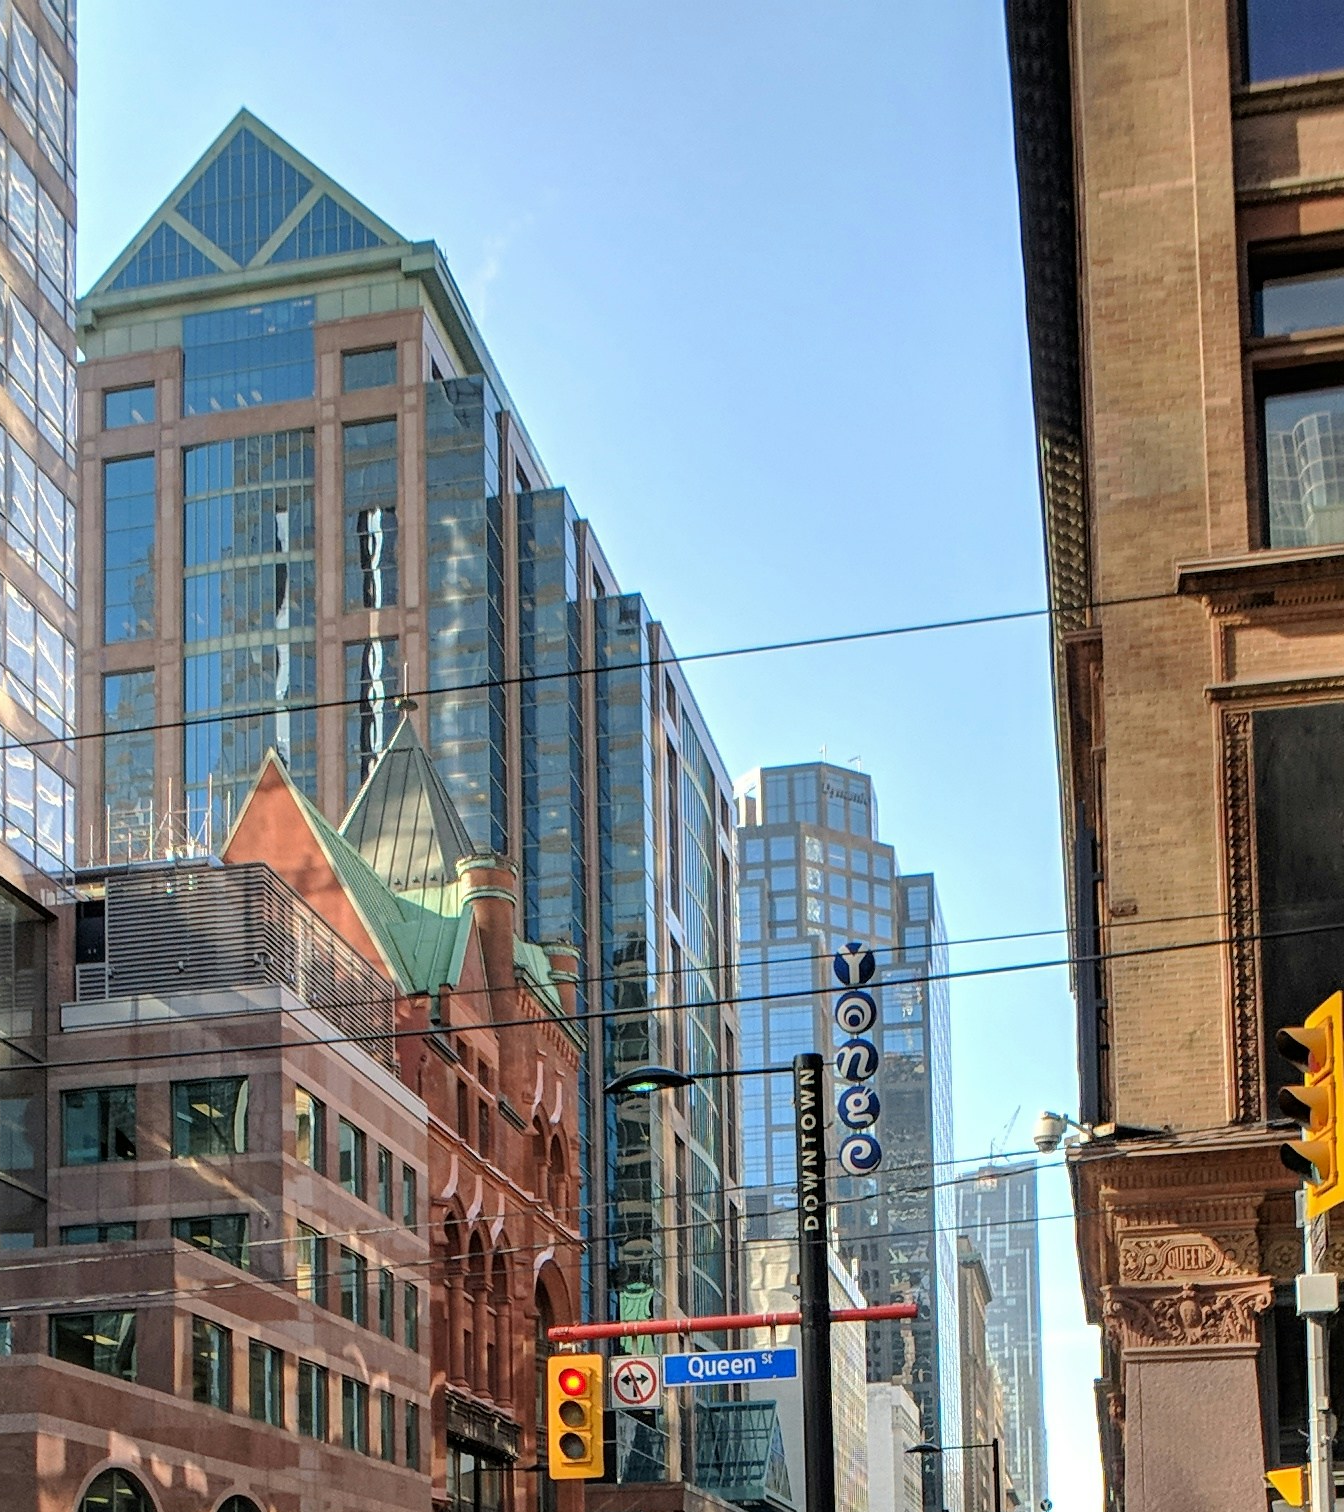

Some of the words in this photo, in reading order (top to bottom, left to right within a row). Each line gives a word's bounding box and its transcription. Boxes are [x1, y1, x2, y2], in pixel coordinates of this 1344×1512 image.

[834, 942, 882, 1176] Yonge
[800, 1069, 820, 1231] DOWNTOWN
[688, 1356, 756, 1379] Queen
[761, 1353, 773, 1365] St
